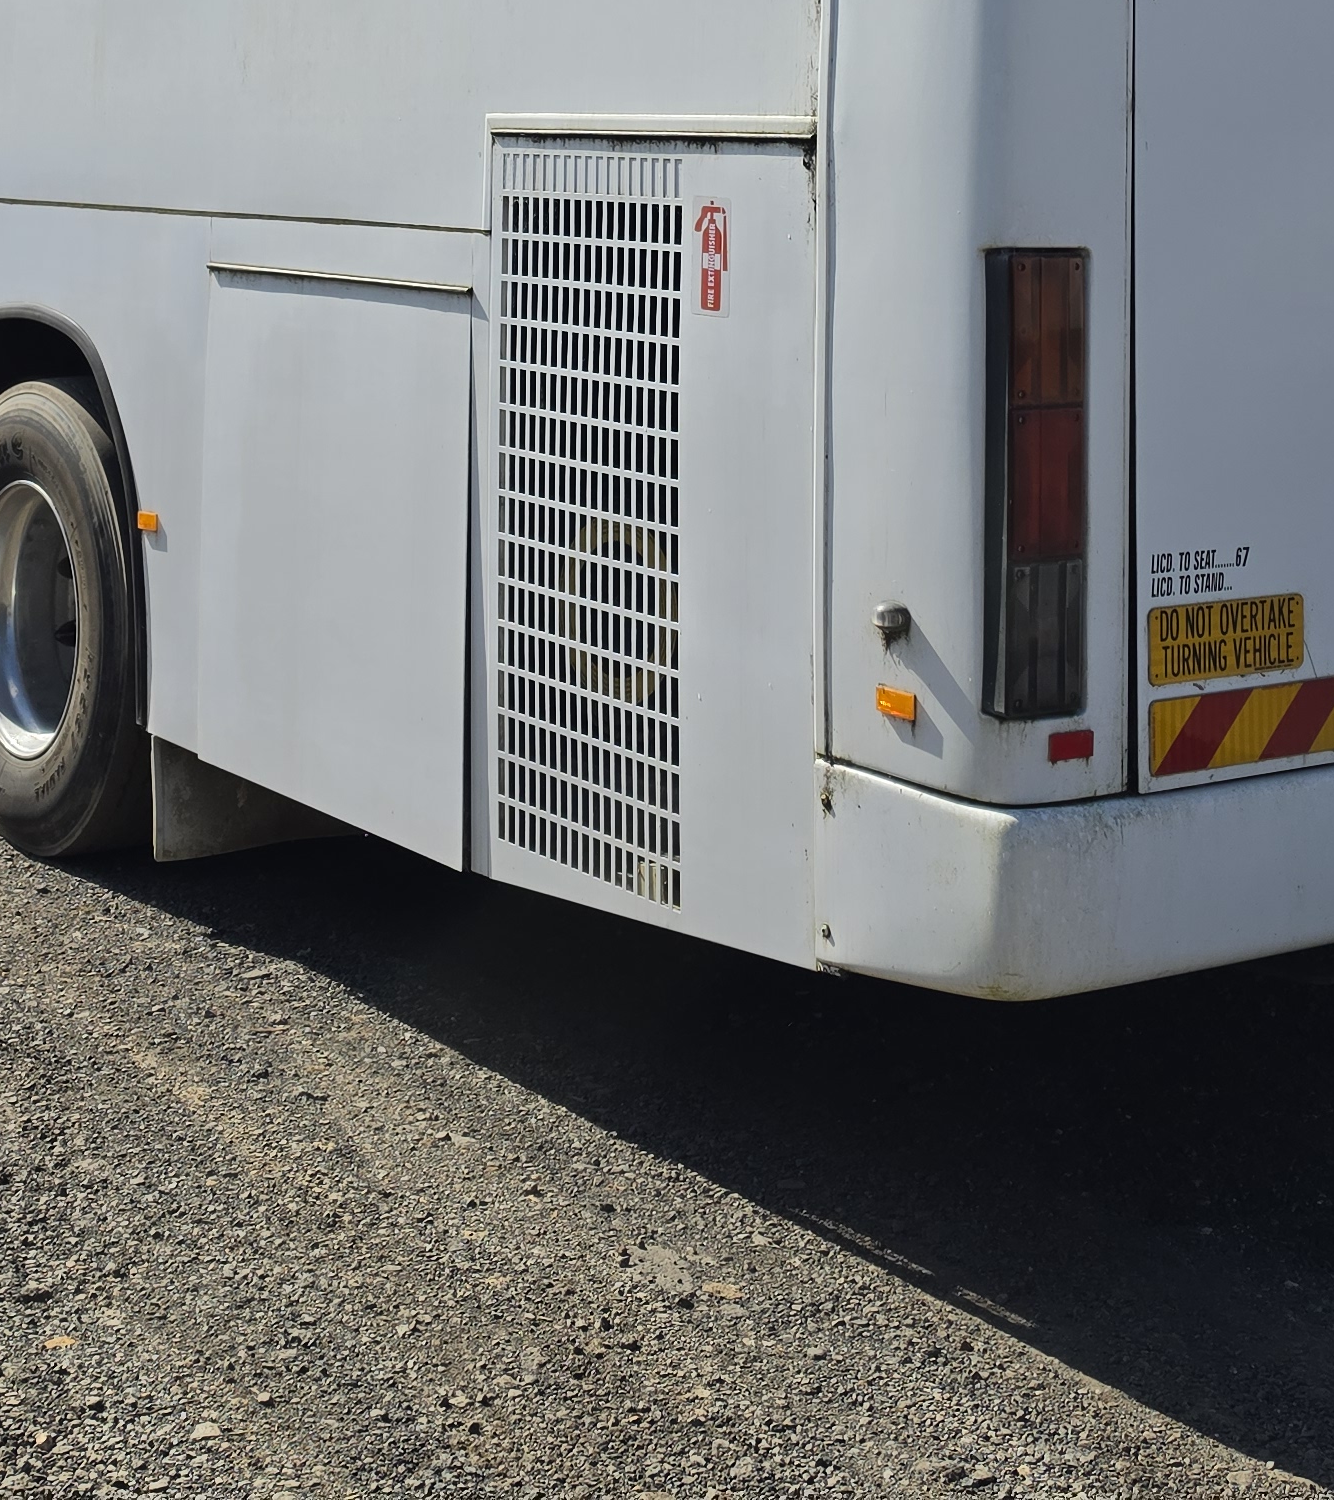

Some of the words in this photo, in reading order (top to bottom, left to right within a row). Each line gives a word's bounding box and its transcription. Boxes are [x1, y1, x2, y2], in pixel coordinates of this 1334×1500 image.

[707, 223, 717, 287] EXTINGUISHER
[707, 288, 716, 308] FIRE
[1150, 552, 1176, 575] LICD.
[1178, 550, 1192, 573] TO
[1151, 576, 1176, 598] LICD.
[1179, 574, 1192, 596] TO
[1159, 608, 1180, 643] DO
[1185, 605, 1214, 640] NOT
[1219, 596, 1296, 636] OVERTAKE
[1162, 638, 1227, 679] TURNING
[1232, 631, 1295, 670] VEHICLE
